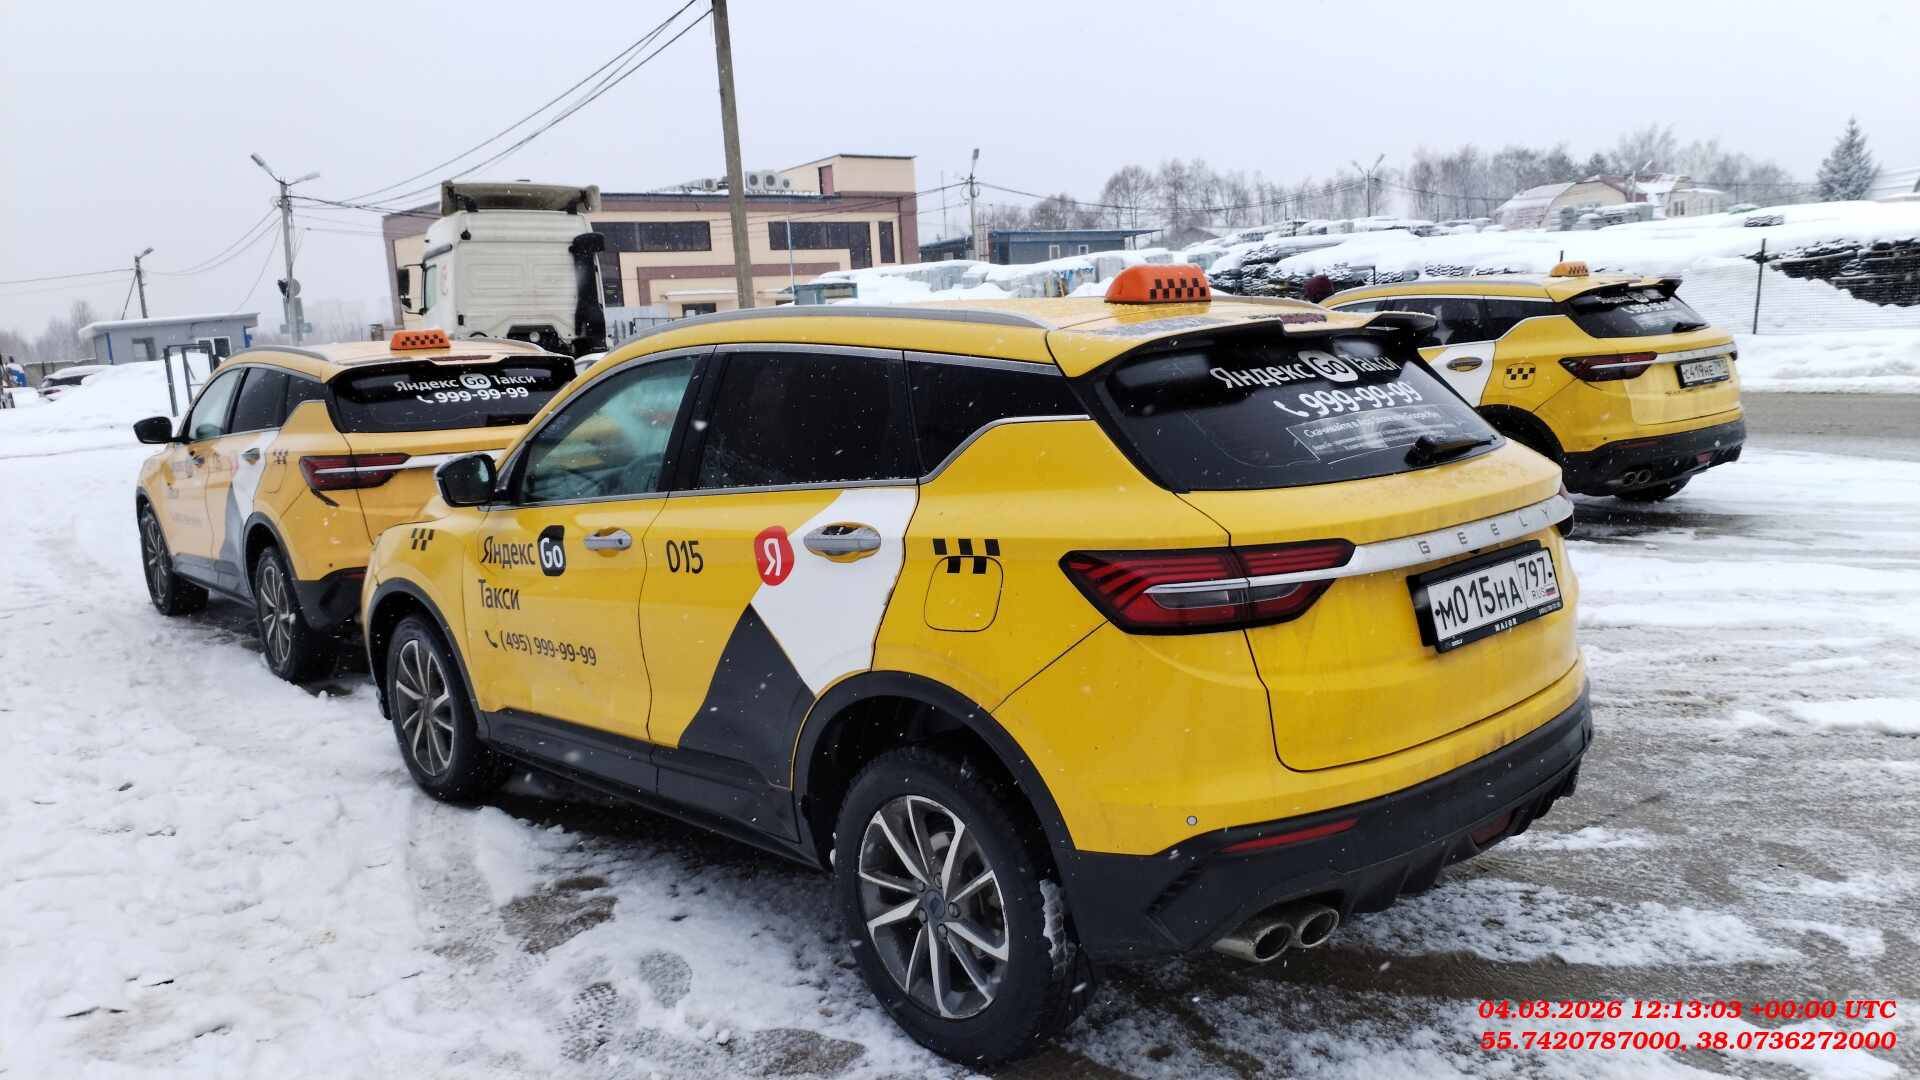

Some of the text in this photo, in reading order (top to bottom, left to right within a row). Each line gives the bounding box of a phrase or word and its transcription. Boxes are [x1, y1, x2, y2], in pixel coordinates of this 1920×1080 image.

[393, 374, 536, 391] Яндекс Go Такси
[1211, 361, 1315, 390] Яндекс
[1348, 353, 1402, 374] Такси
[434, 386, 529, 404] 999-99-99
[1297, 381, 1424, 416] 999-99-99
[1417, 507, 1552, 555] GEELY
[479, 535, 536, 568] Яндекс
[666, 539, 704, 575] 015
[478, 578, 521, 611] Такси
[500, 629, 598, 667] (495) 999-99-99
